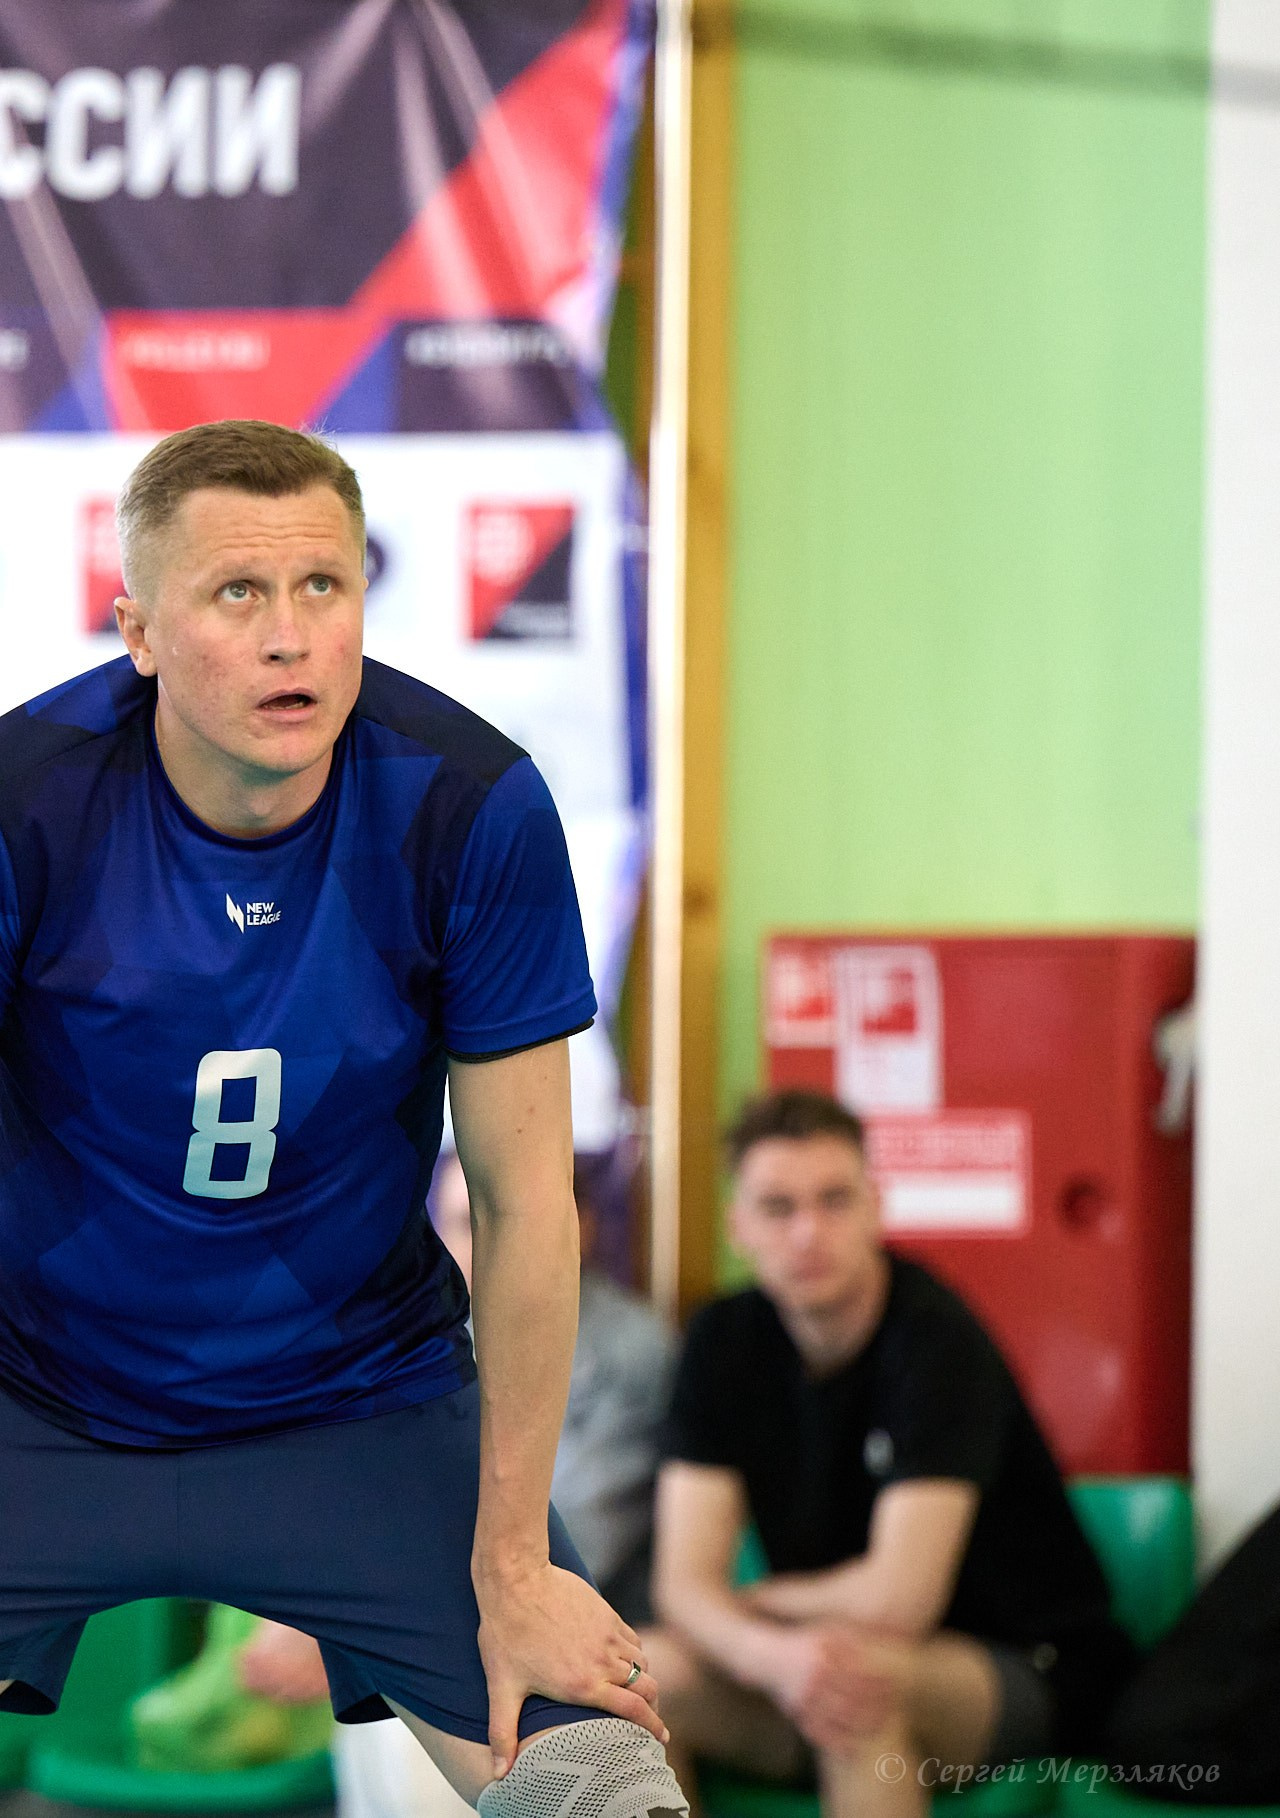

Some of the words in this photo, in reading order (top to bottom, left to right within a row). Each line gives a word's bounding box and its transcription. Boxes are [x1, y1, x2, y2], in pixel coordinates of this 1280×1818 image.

[246, 902, 274, 914] NEW
[246, 910, 282, 926] LEAGUE
[182, 1048, 282, 1199] 8
